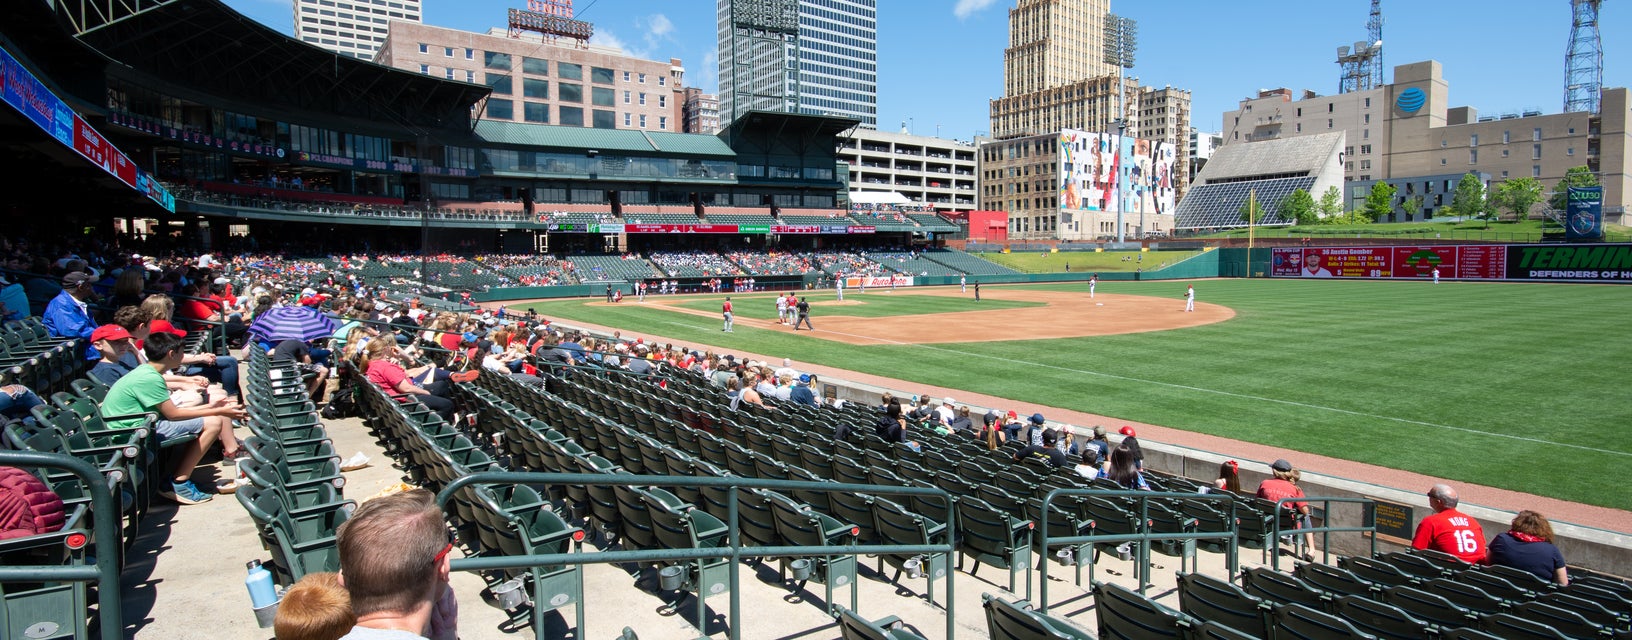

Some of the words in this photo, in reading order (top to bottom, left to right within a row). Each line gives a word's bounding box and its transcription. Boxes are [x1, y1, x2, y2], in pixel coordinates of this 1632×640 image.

[1519, 247, 1632, 268] TERMIN
[1529, 270, 1599, 278] DEFENDERS
[1601, 270, 1618, 278] OF
[1448, 516, 1469, 527] WONG
[1454, 530, 1478, 553] 16
